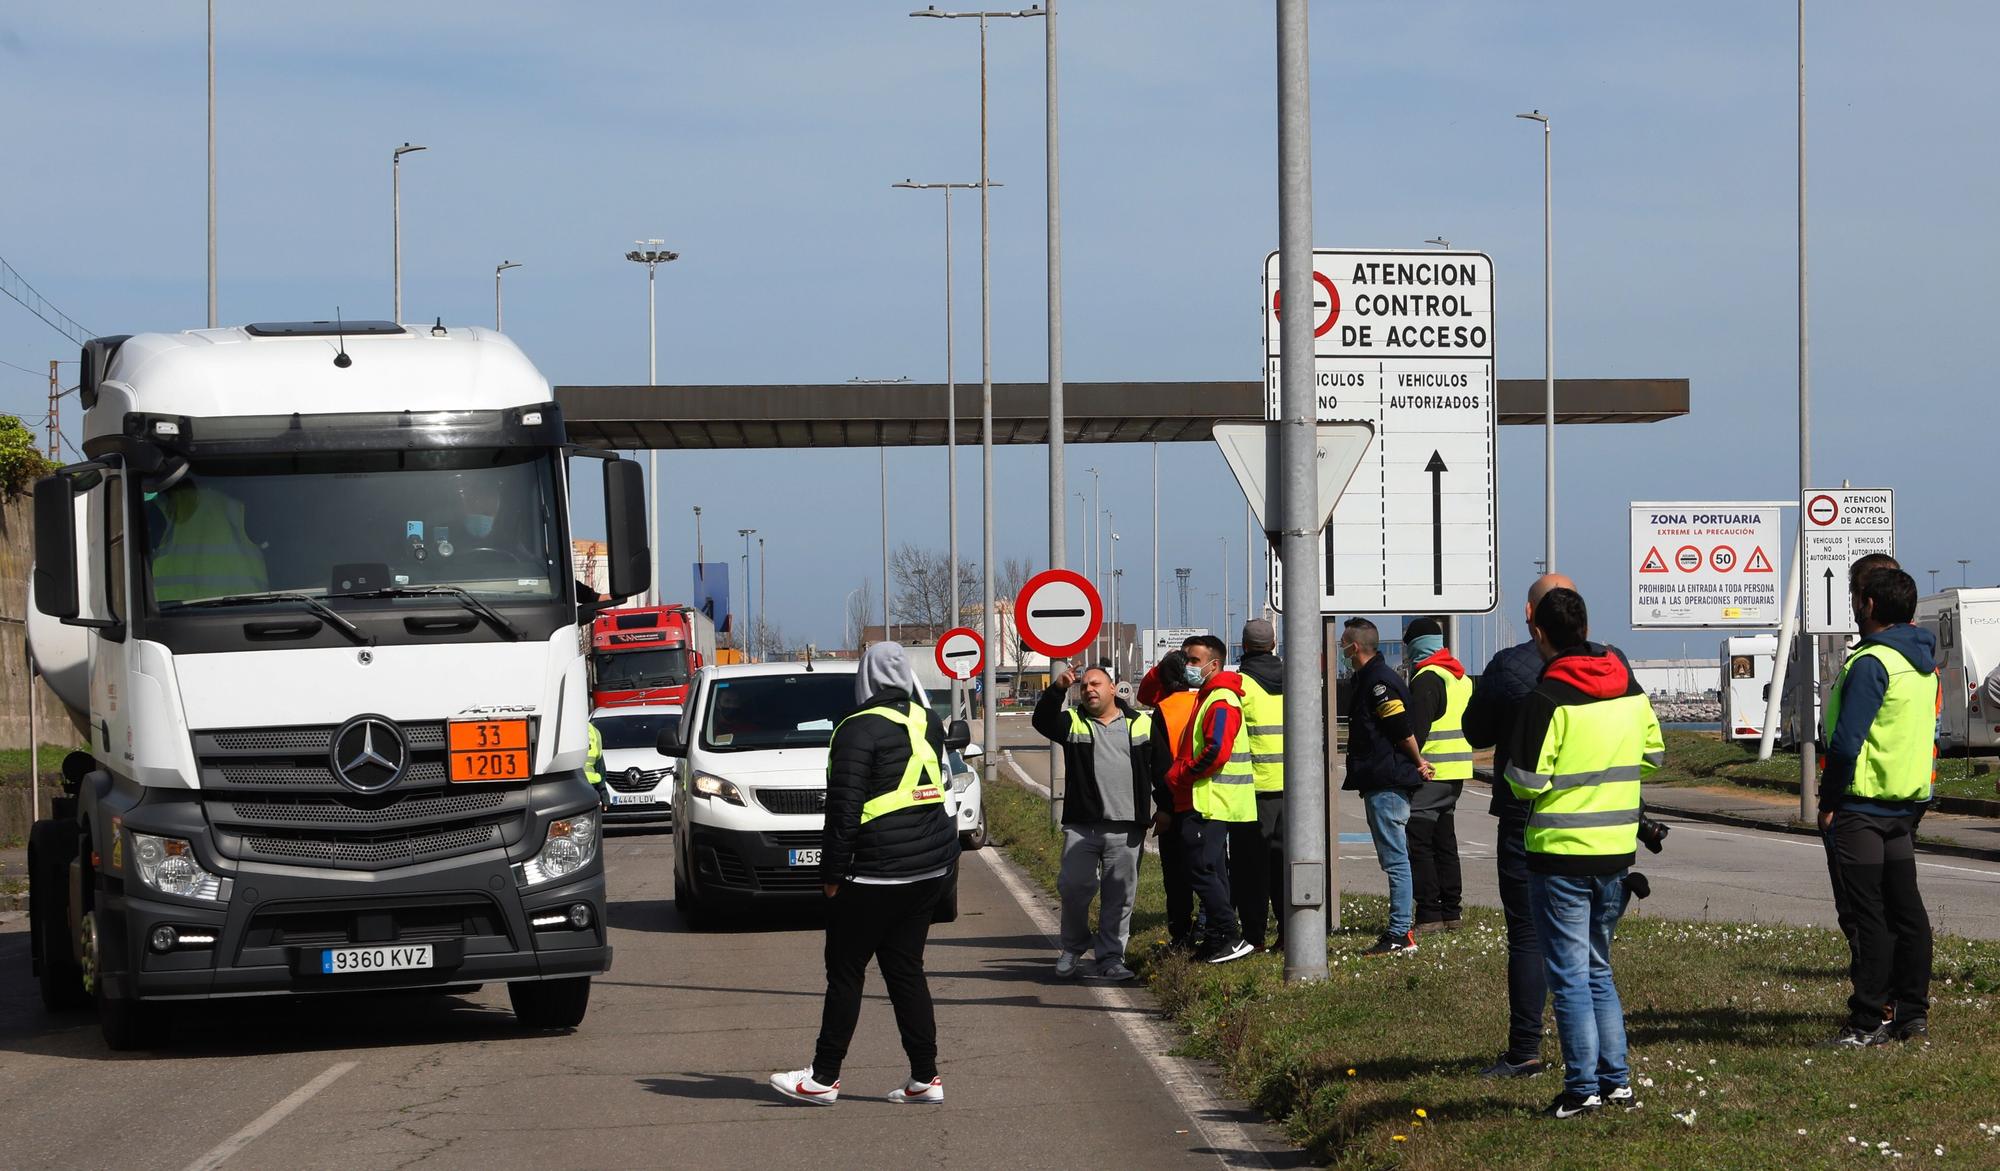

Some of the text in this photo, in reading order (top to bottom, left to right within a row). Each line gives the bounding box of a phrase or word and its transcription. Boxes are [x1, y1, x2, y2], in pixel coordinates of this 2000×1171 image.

[1352, 263, 1476, 286] ATENCION
[1355, 294, 1472, 316] CONTROL
[1342, 325, 1487, 348] DE ACCESO
[1316, 373, 1365, 386] ICULOS
[1398, 374, 1468, 387] VEHICULOS
[1318, 396, 1338, 409] NO
[1390, 396, 1479, 409] AUTORIZADOS
[1650, 514, 1762, 524] ZONA PORTUARIA
[1706, 526, 1755, 536] PRECAUCIÓN
[1715, 554, 1731, 564] 50
[1638, 584, 1775, 593] PROHIBIDA LA ENTRADA A TODA PERSONA
[1638, 596, 1775, 605] AJENA A LAS OPERACIONES PORTUARIAS
[476, 725, 501, 747] 33
[466, 754, 516, 775] 1203
[798, 851, 822, 864] 458
[336, 950, 384, 970] 9360
[392, 948, 427, 966] KVZ
